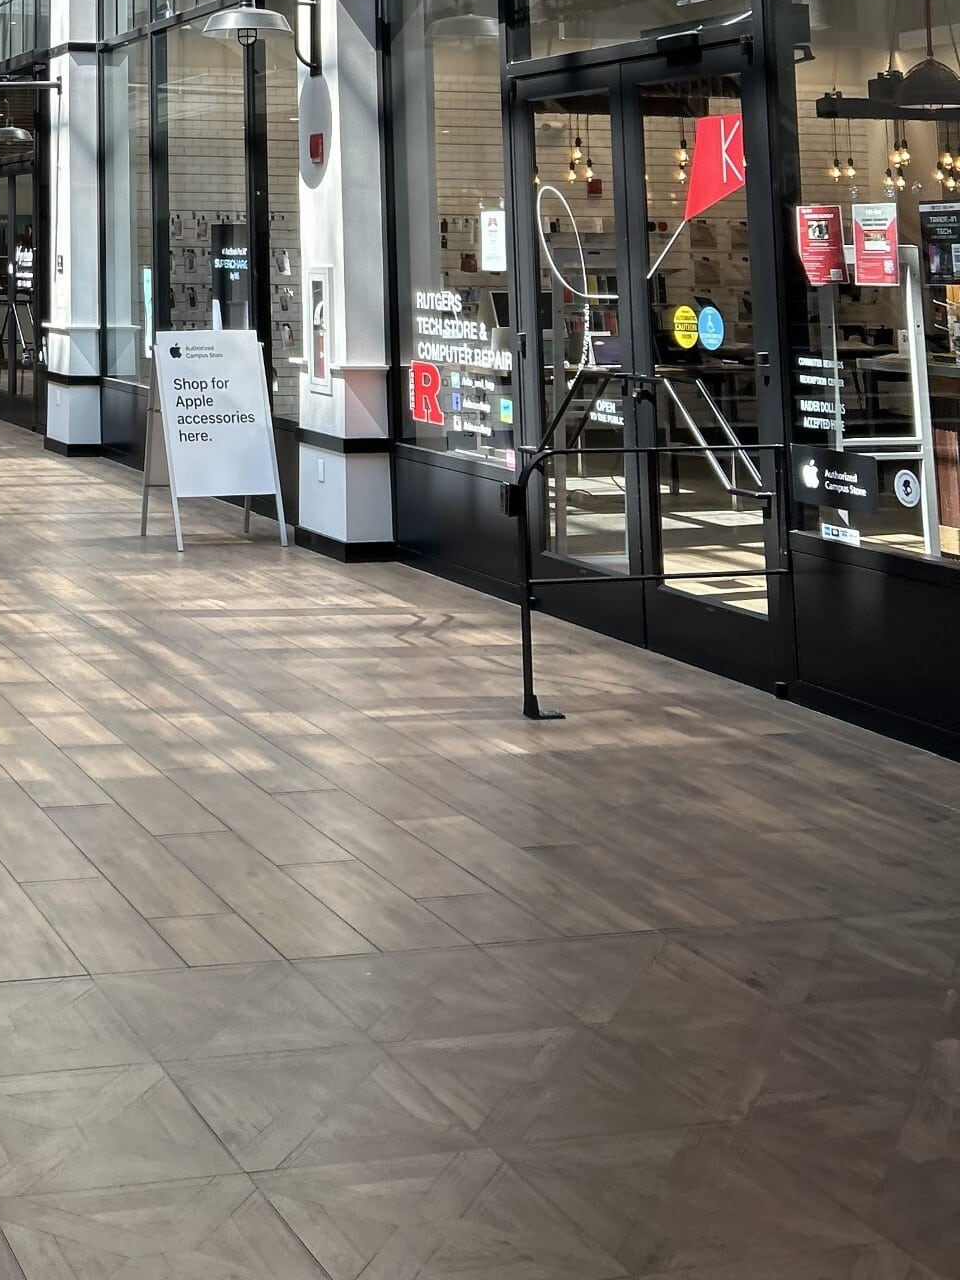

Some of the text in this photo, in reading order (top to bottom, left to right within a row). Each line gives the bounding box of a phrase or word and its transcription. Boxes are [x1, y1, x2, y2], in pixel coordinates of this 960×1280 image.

[720, 118, 744, 184] K
[415, 290, 463, 313] RUTGERS
[416, 316, 489, 341] TECH STORE &
[417, 341, 513, 371] COMPUTER REPAIR
[173, 376, 230, 393] Shop for
[411, 360, 445, 426] R
[175, 394, 214, 410] Apple
[596, 399, 616, 414] OPEN
[820, 401, 846, 415] DOLLS
[177, 410, 256, 425] accessories
[830, 419, 846, 432] HE
[179, 429, 213, 443] here.
[824, 468, 858, 483] Authorized
[824, 480, 867, 497] Campus Store
